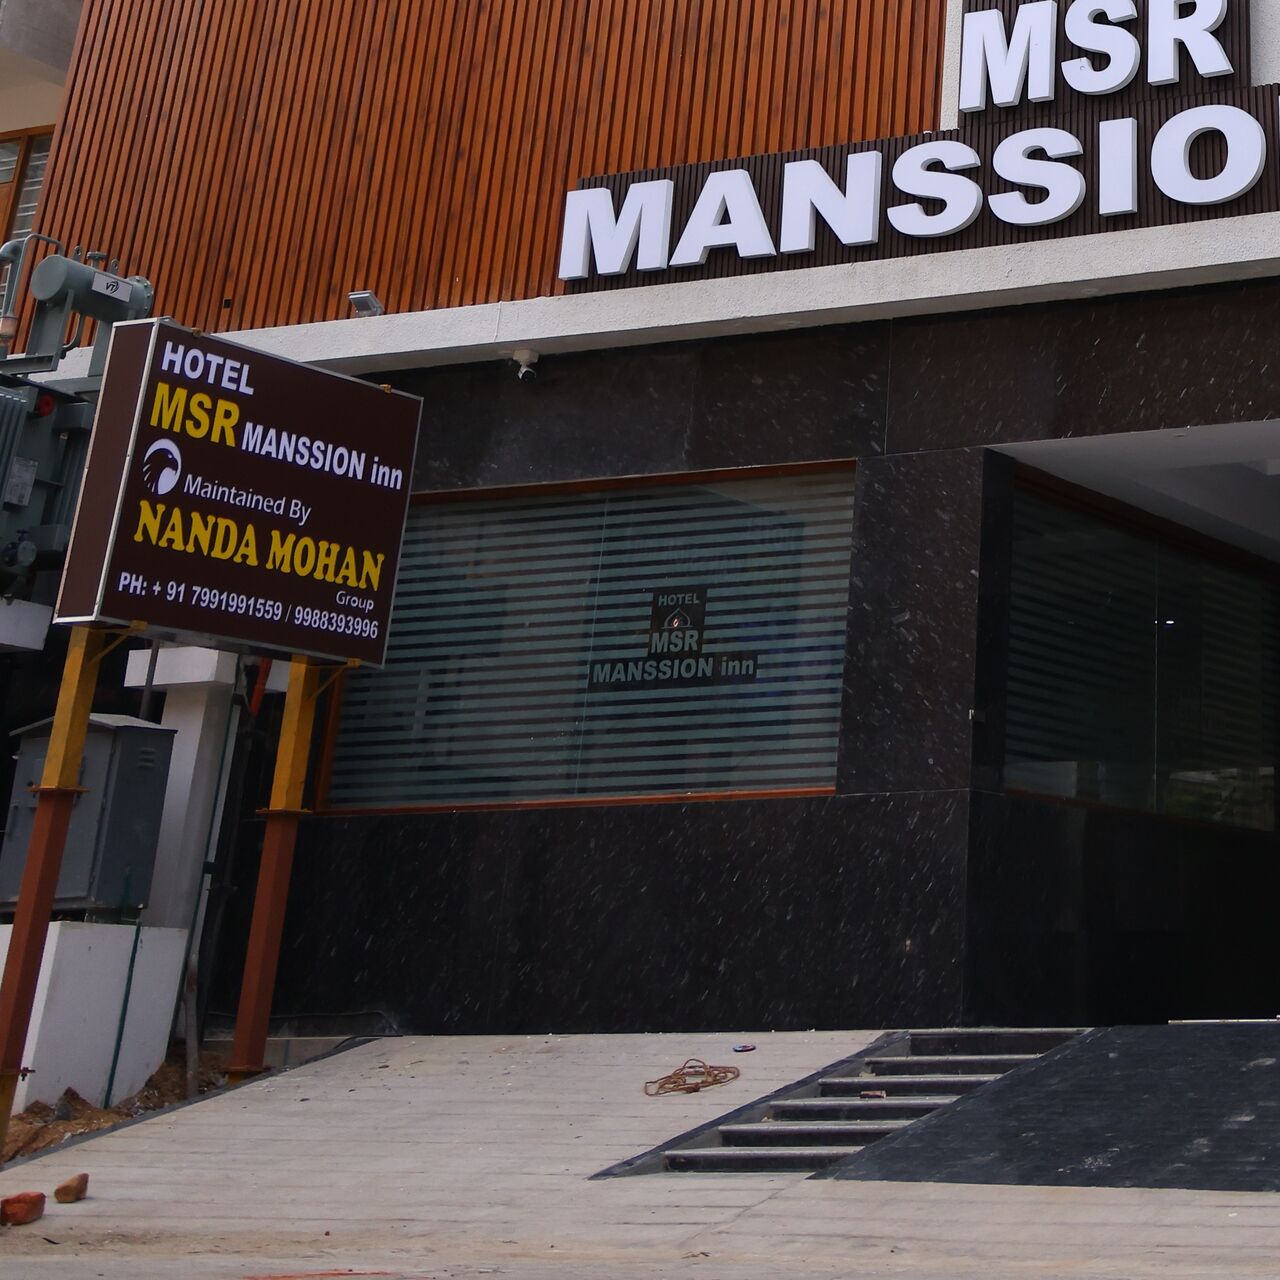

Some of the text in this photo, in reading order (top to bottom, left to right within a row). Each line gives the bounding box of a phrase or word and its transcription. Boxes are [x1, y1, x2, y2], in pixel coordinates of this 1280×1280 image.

[161, 341, 254, 395] HOTEL
[150, 382, 403, 490] MSR MANSSION inn
[184, 474, 311, 526] Maintained By
[134, 500, 385, 591] NANDA MOHAN
[118, 572, 147, 595] PH:
[166, 581, 184, 602] 91
[191, 586, 283, 621] 7991991559
[294, 606, 379, 639] 9988393996
[336, 591, 374, 613] Group
[658, 593, 699, 606] HOTEL
[651, 630, 698, 653] MSR
[593, 657, 754, 683] MANSSION inn
